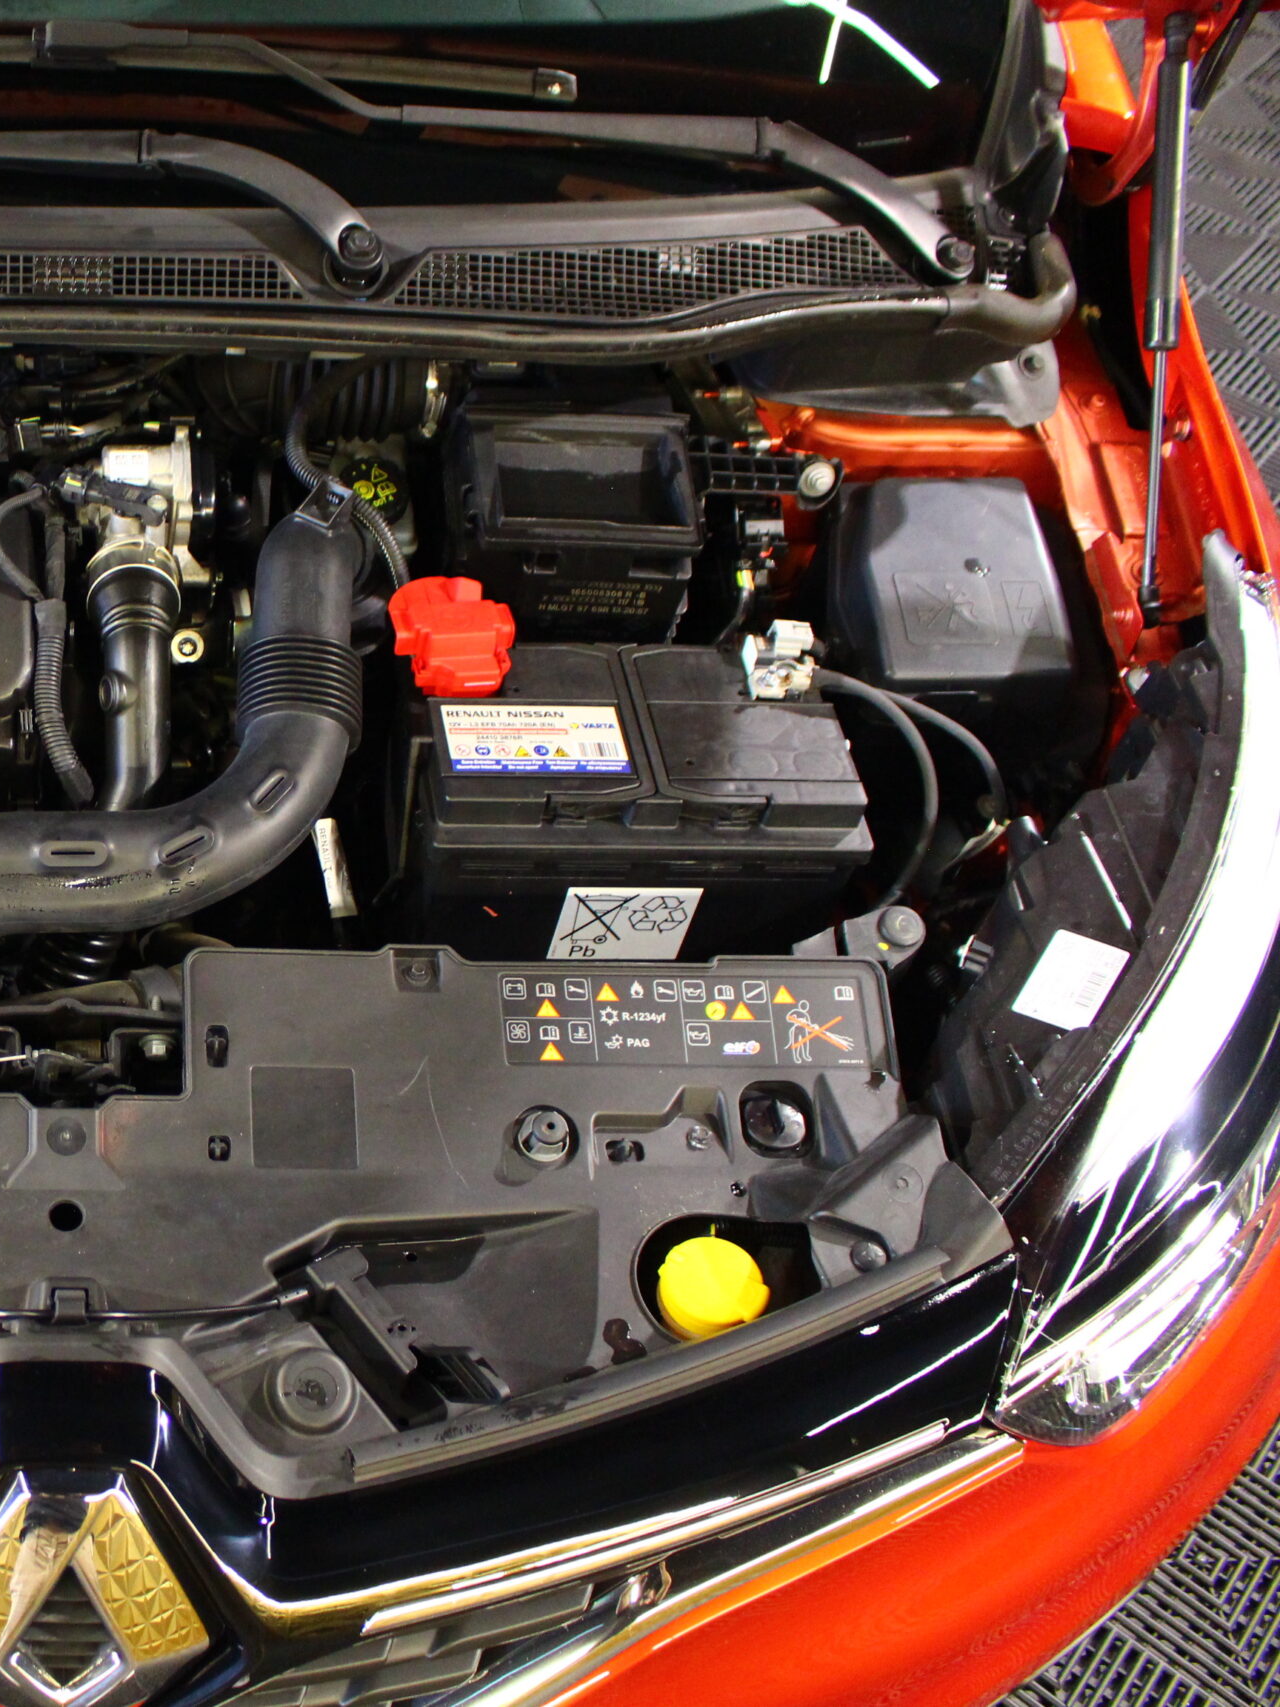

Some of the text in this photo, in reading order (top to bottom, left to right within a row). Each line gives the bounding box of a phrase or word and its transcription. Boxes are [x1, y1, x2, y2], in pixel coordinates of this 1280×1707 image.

[446, 710, 565, 718] RENAULT NISSAN
[318, 827, 334, 872] RENAULT
[568, 945, 596, 958] Pb
[621, 1011, 666, 1024] R-1234yf
[626, 1037, 651, 1048] PAG
